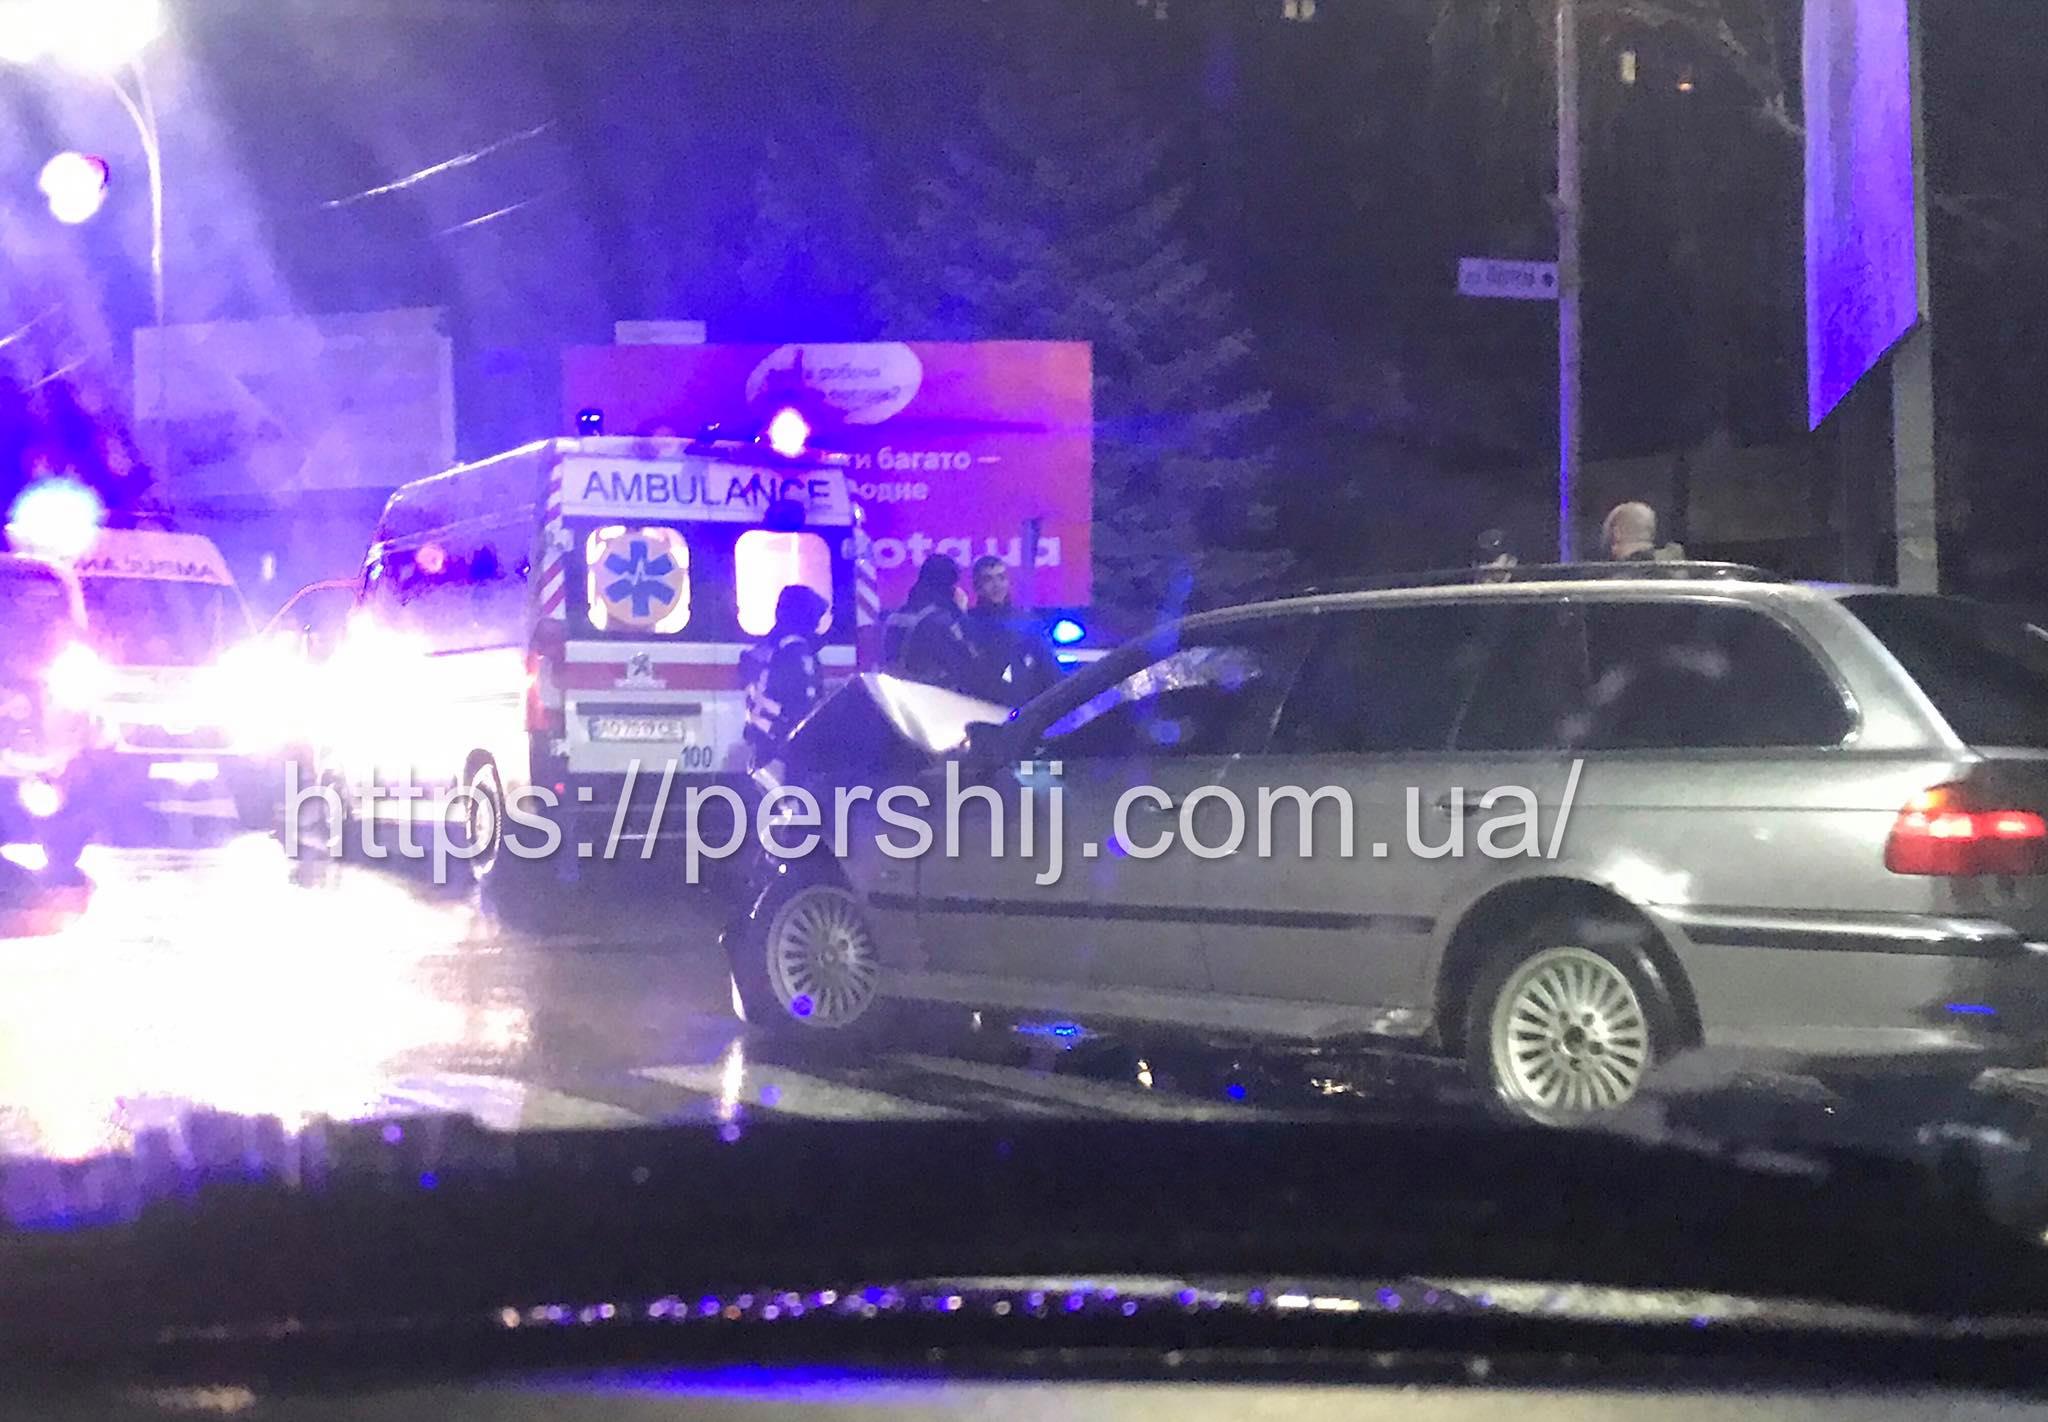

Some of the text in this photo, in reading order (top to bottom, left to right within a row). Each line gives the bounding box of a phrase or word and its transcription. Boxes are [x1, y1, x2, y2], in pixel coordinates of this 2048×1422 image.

[877, 446, 971, 471] багато
[583, 470, 833, 509] AMBULANCE
[681, 745, 713, 768] 100
